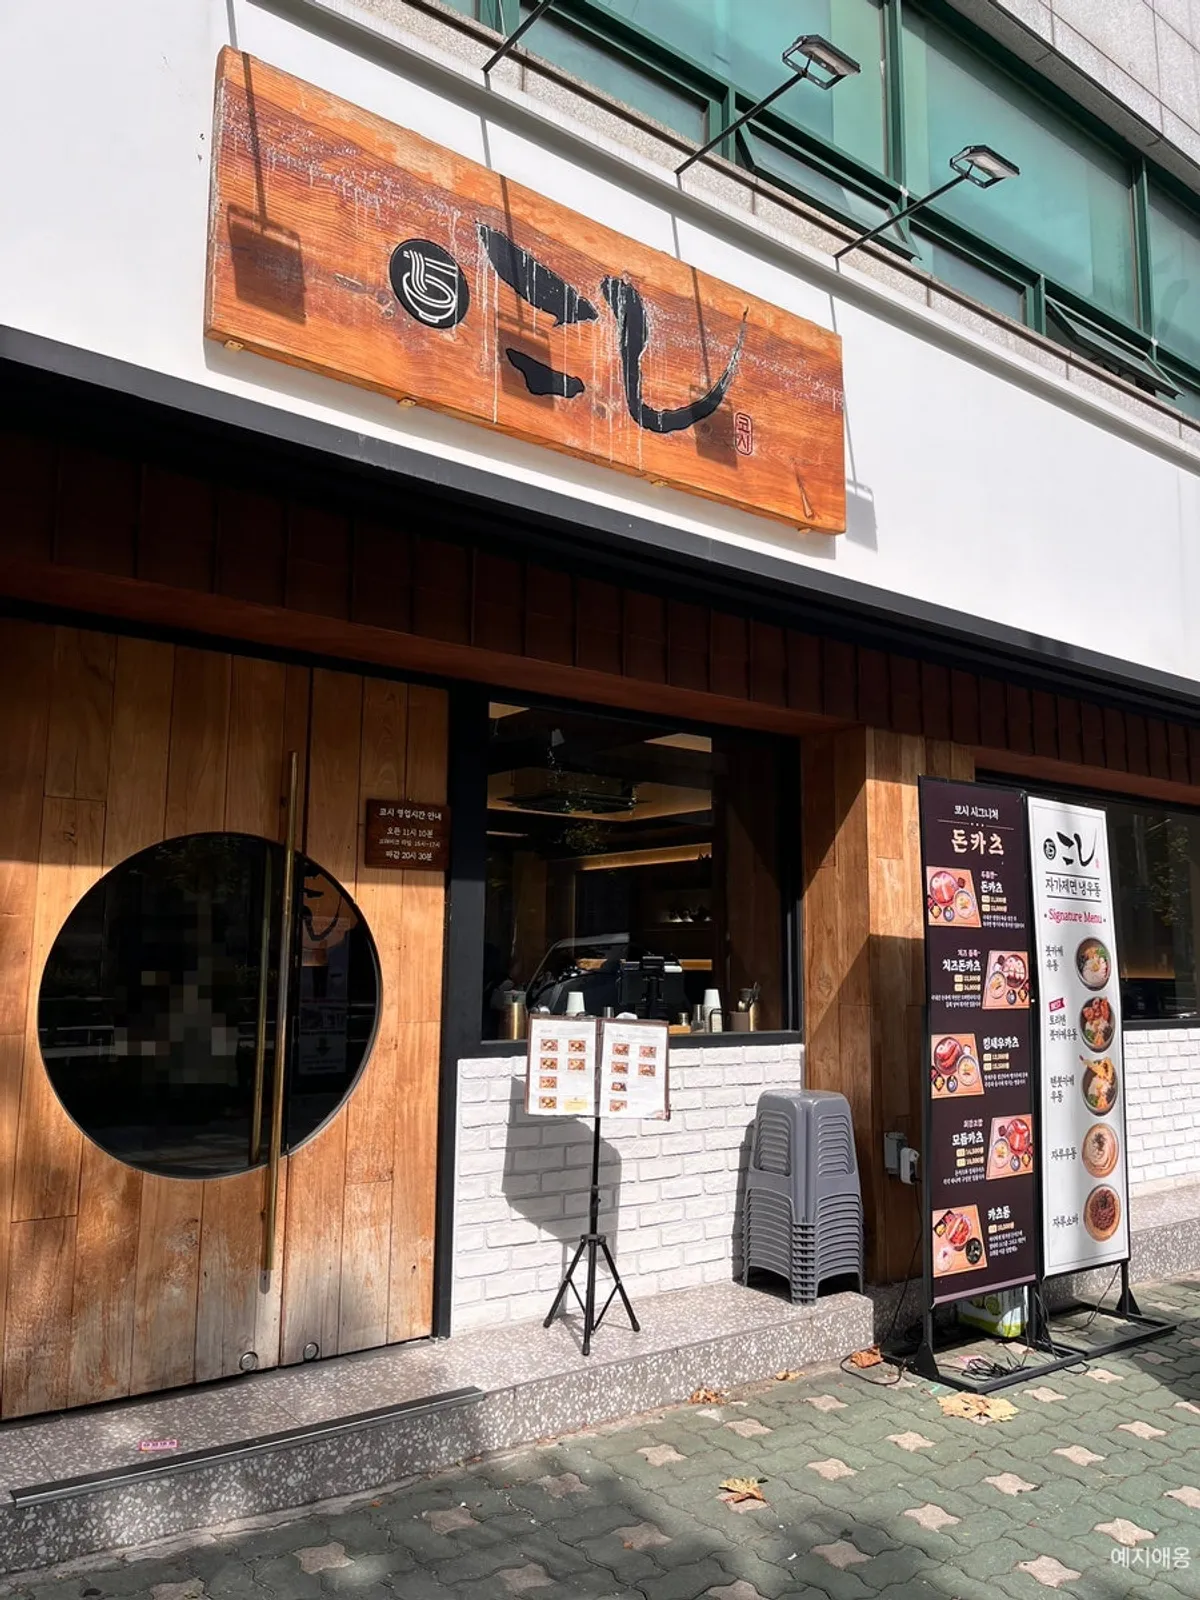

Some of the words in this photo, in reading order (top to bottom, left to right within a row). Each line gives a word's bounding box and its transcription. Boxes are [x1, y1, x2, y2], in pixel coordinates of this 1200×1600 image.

[379, 807, 395, 817] 코시
[397, 808, 426, 820] 영업시간
[427, 811, 442, 821] 안내
[970, 806, 999, 820] 시그니처
[387, 826, 401, 836] 오픈
[402, 828, 417, 837] 11시
[385, 850, 400, 860] 마감
[401, 851, 417, 860] 20시
[1045, 877, 1077, 895] 자가제면
[1078, 880, 1102, 898] 냉우동
[1048, 908, 1083, 924] Signature
[1084, 912, 1103, 924] Menu
[942, 958, 982, 972] 치즈돈카츠
[1046, 959, 1060, 972] 우동
[1050, 1090, 1064, 1104] 우동
